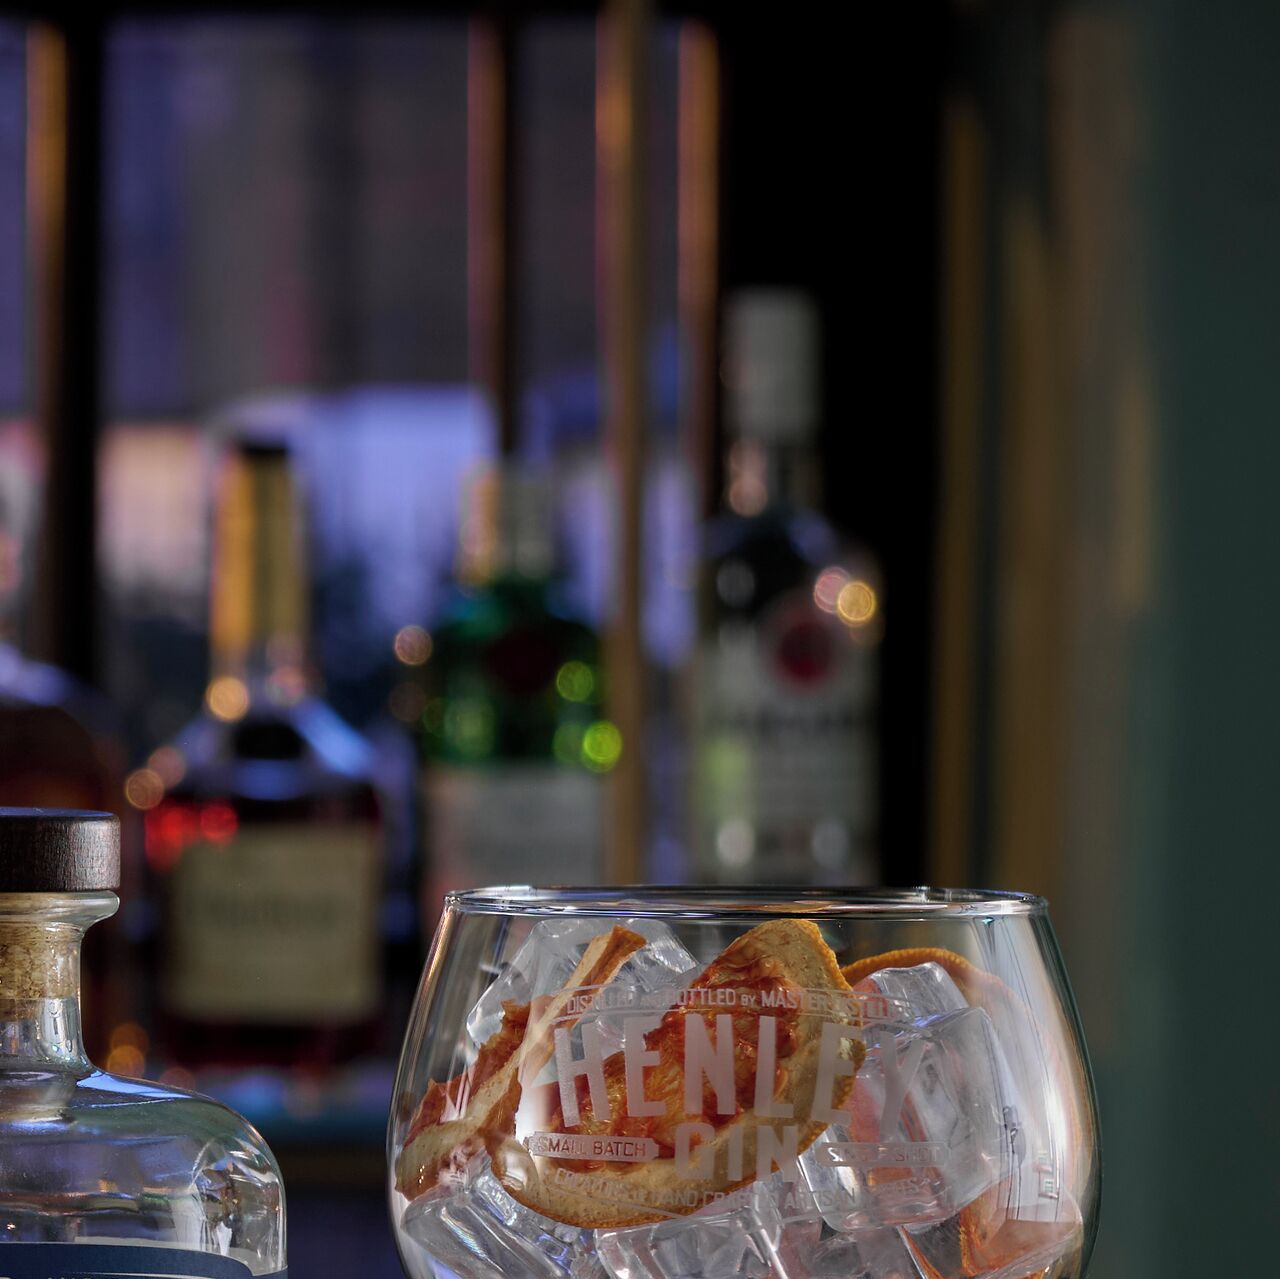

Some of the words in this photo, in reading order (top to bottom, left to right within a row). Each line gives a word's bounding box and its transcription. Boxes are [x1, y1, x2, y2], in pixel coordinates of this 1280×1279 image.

[553, 1013, 930, 1130] HENLEY
[539, 1136, 588, 1156] SMALL
[592, 1140, 647, 1158] BATCH
[674, 1122, 799, 1184] GIN
